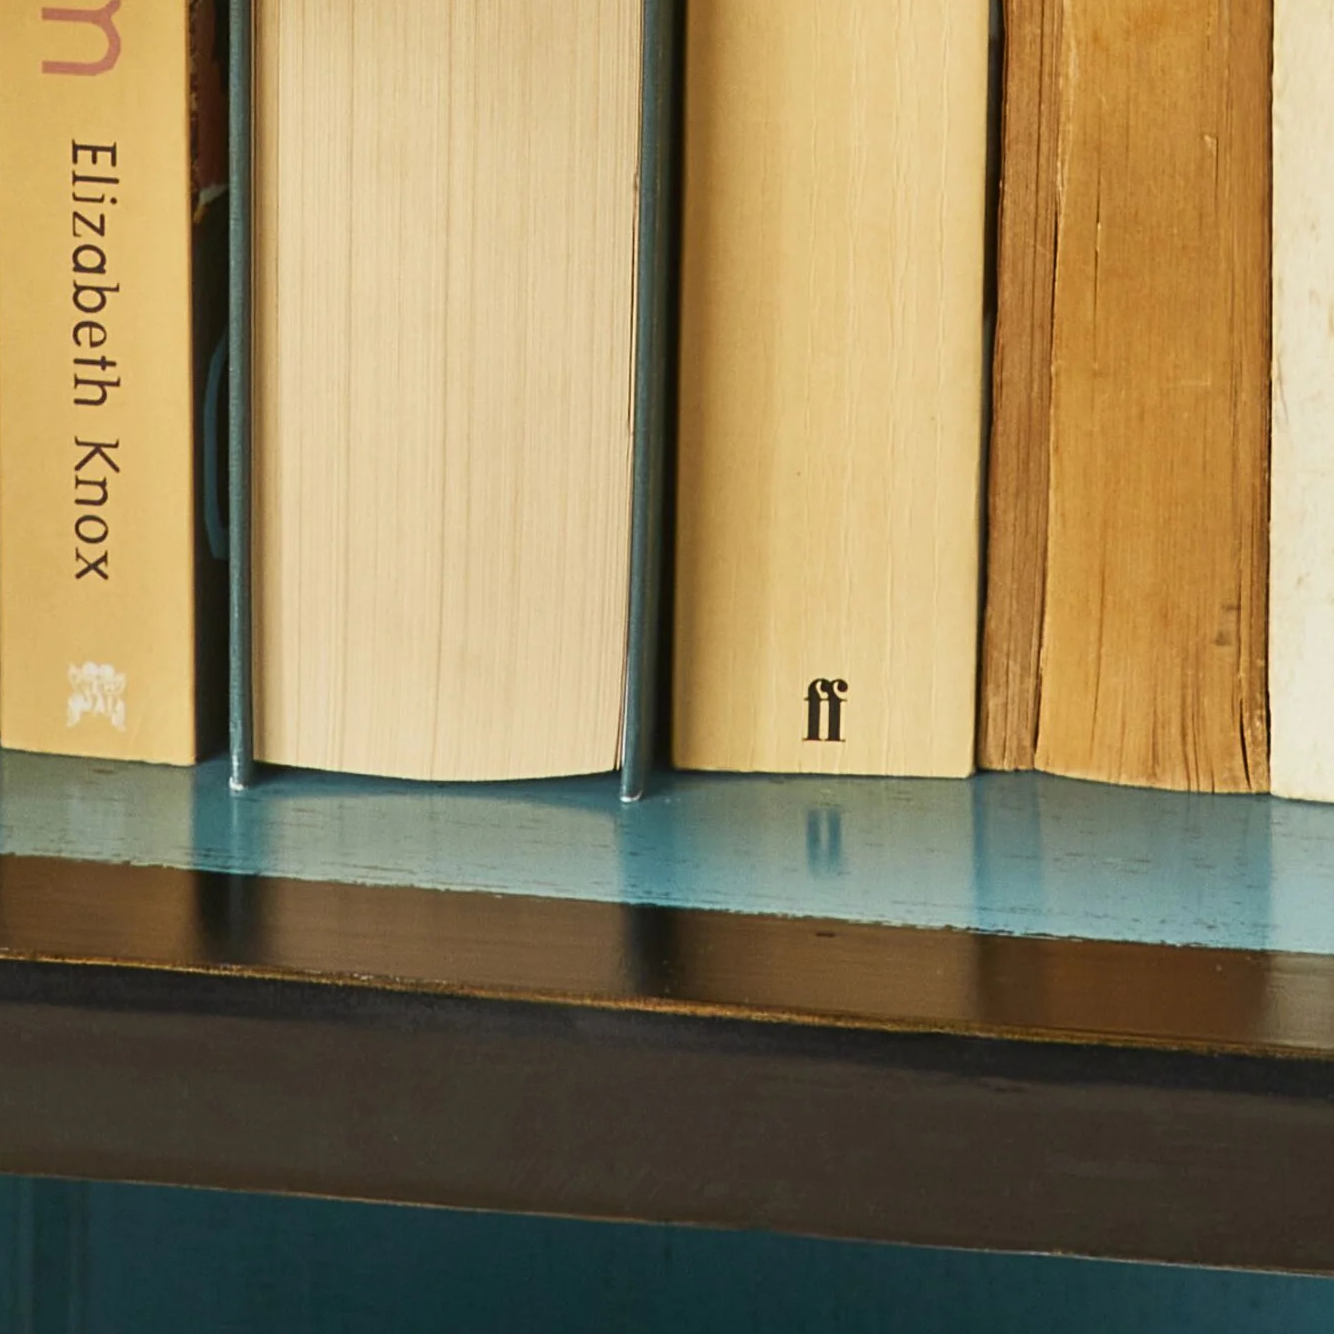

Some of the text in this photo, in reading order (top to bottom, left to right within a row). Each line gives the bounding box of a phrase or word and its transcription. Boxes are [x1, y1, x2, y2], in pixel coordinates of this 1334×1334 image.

[70, 137, 122, 582] Elizabeth Knox
[802, 677, 849, 744] ff
